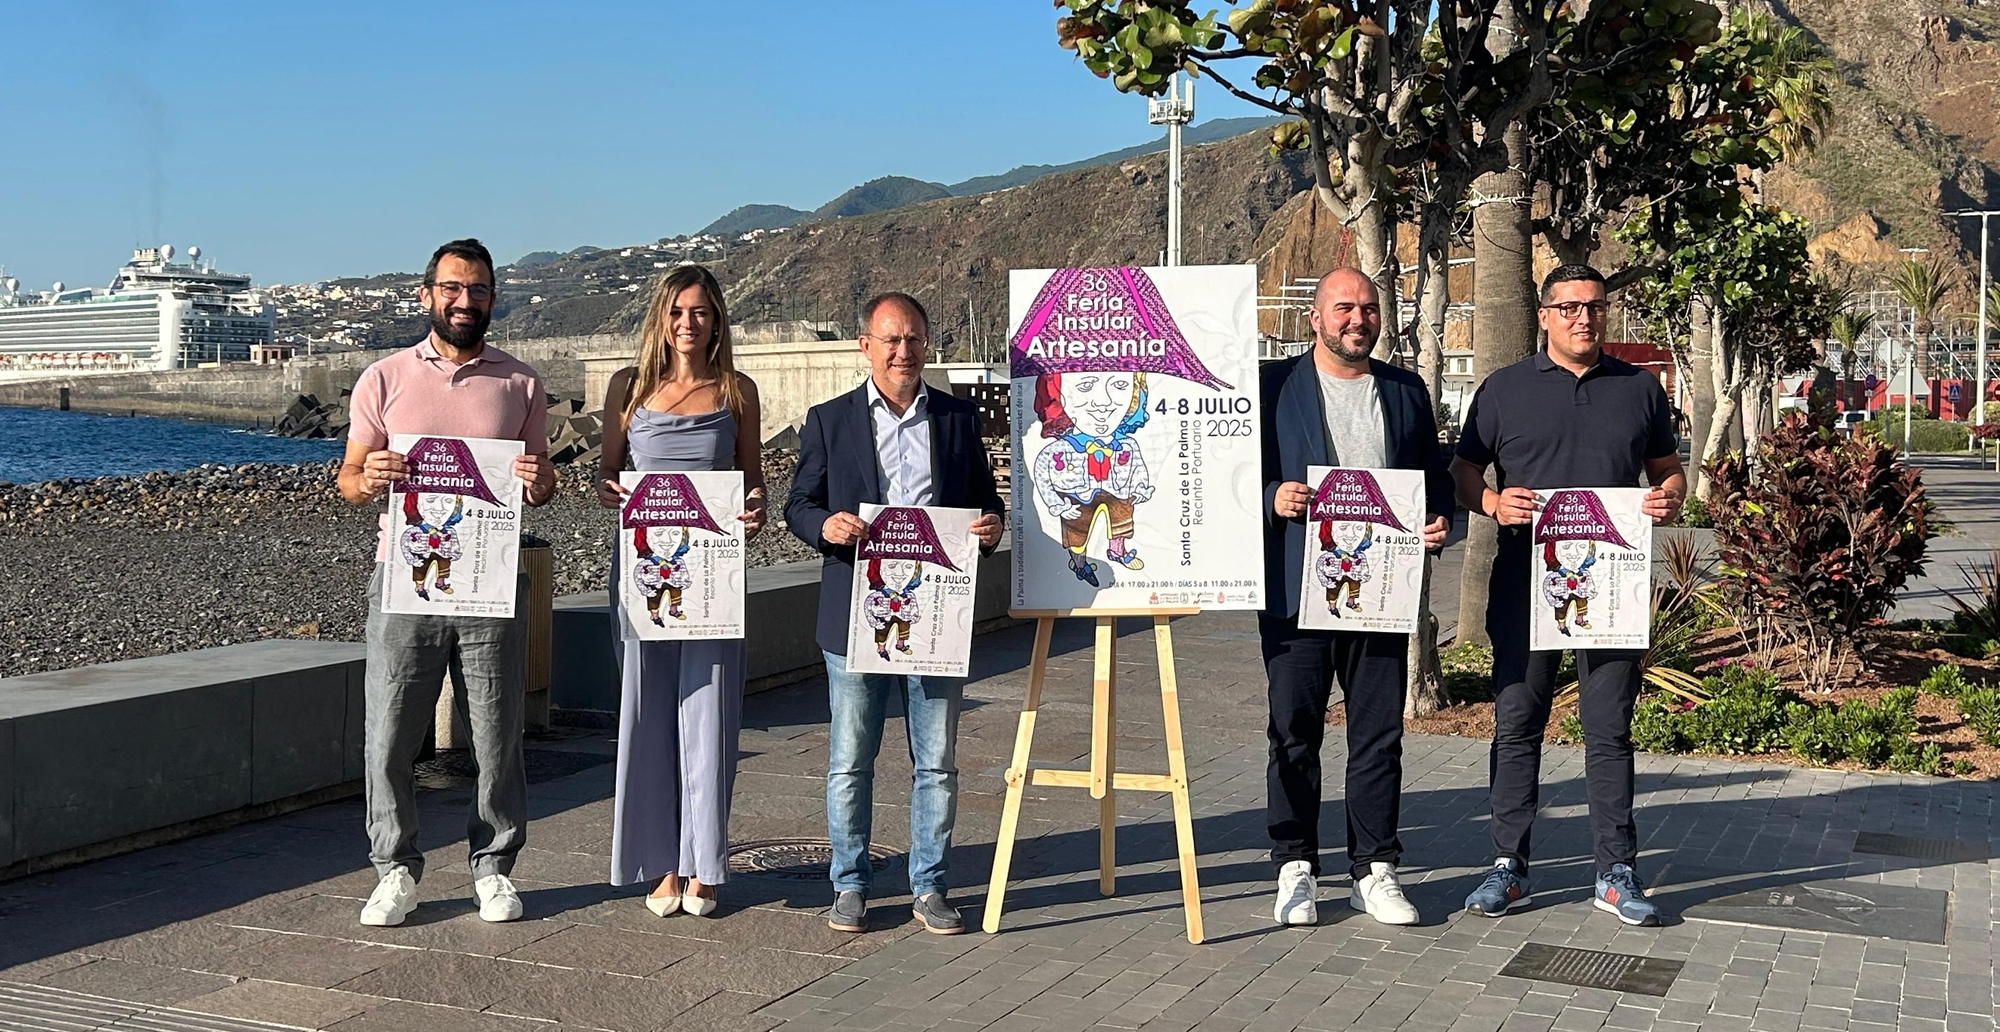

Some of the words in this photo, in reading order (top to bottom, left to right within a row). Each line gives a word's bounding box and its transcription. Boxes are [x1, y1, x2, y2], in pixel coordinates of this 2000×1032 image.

[1083, 274, 1108, 292] 36
[1067, 294, 1122, 312] Feria
[1058, 313, 1134, 331] Insular
[1026, 332, 1166, 358] Artesanía
[1194, 397, 1251, 415] JULIO
[1206, 420, 1252, 437] 2025
[1178, 420, 1189, 458] Palma
[433, 442, 447, 452] 36
[1192, 420, 1202, 474] Portuario
[424, 452, 454, 463] Feria
[418, 462, 459, 473] Insular
[1179, 462, 1189, 475] La
[657, 478, 670, 487] 36
[1342, 473, 1354, 482] 36
[650, 488, 678, 497] Feria
[1179, 480, 1190, 496] de
[1335, 483, 1362, 493] Feria
[645, 497, 683, 507] Insular
[1192, 478, 1203, 525] Recinto
[1331, 492, 1367, 502] Insular
[1566, 494, 1578, 503] 36
[629, 507, 699, 520] Artesanía
[1180, 500, 1190, 527] Cruz
[1315, 502, 1382, 516] Artesanía
[1559, 504, 1586, 513] Feria
[486, 510, 515, 520] JULIO
[895, 512, 908, 521] 36
[1555, 513, 1591, 522] Insular
[491, 521, 514, 531] 2025
[887, 521, 915, 530] Feria
[1540, 521, 1606, 536] Artesanía
[881, 530, 919, 540] Insular
[712, 538, 739, 548] JULIO
[1393, 536, 1419, 545] JULIO
[864, 541, 933, 554] Artesanía
[1180, 531, 1191, 566] Santa
[1398, 547, 1419, 555] 2025
[717, 550, 739, 558] 2025
[1617, 553, 1645, 561] JULIO
[1623, 563, 1645, 571] 2025
[943, 575, 970, 584] JULIO
[948, 586, 970, 595] 2025
